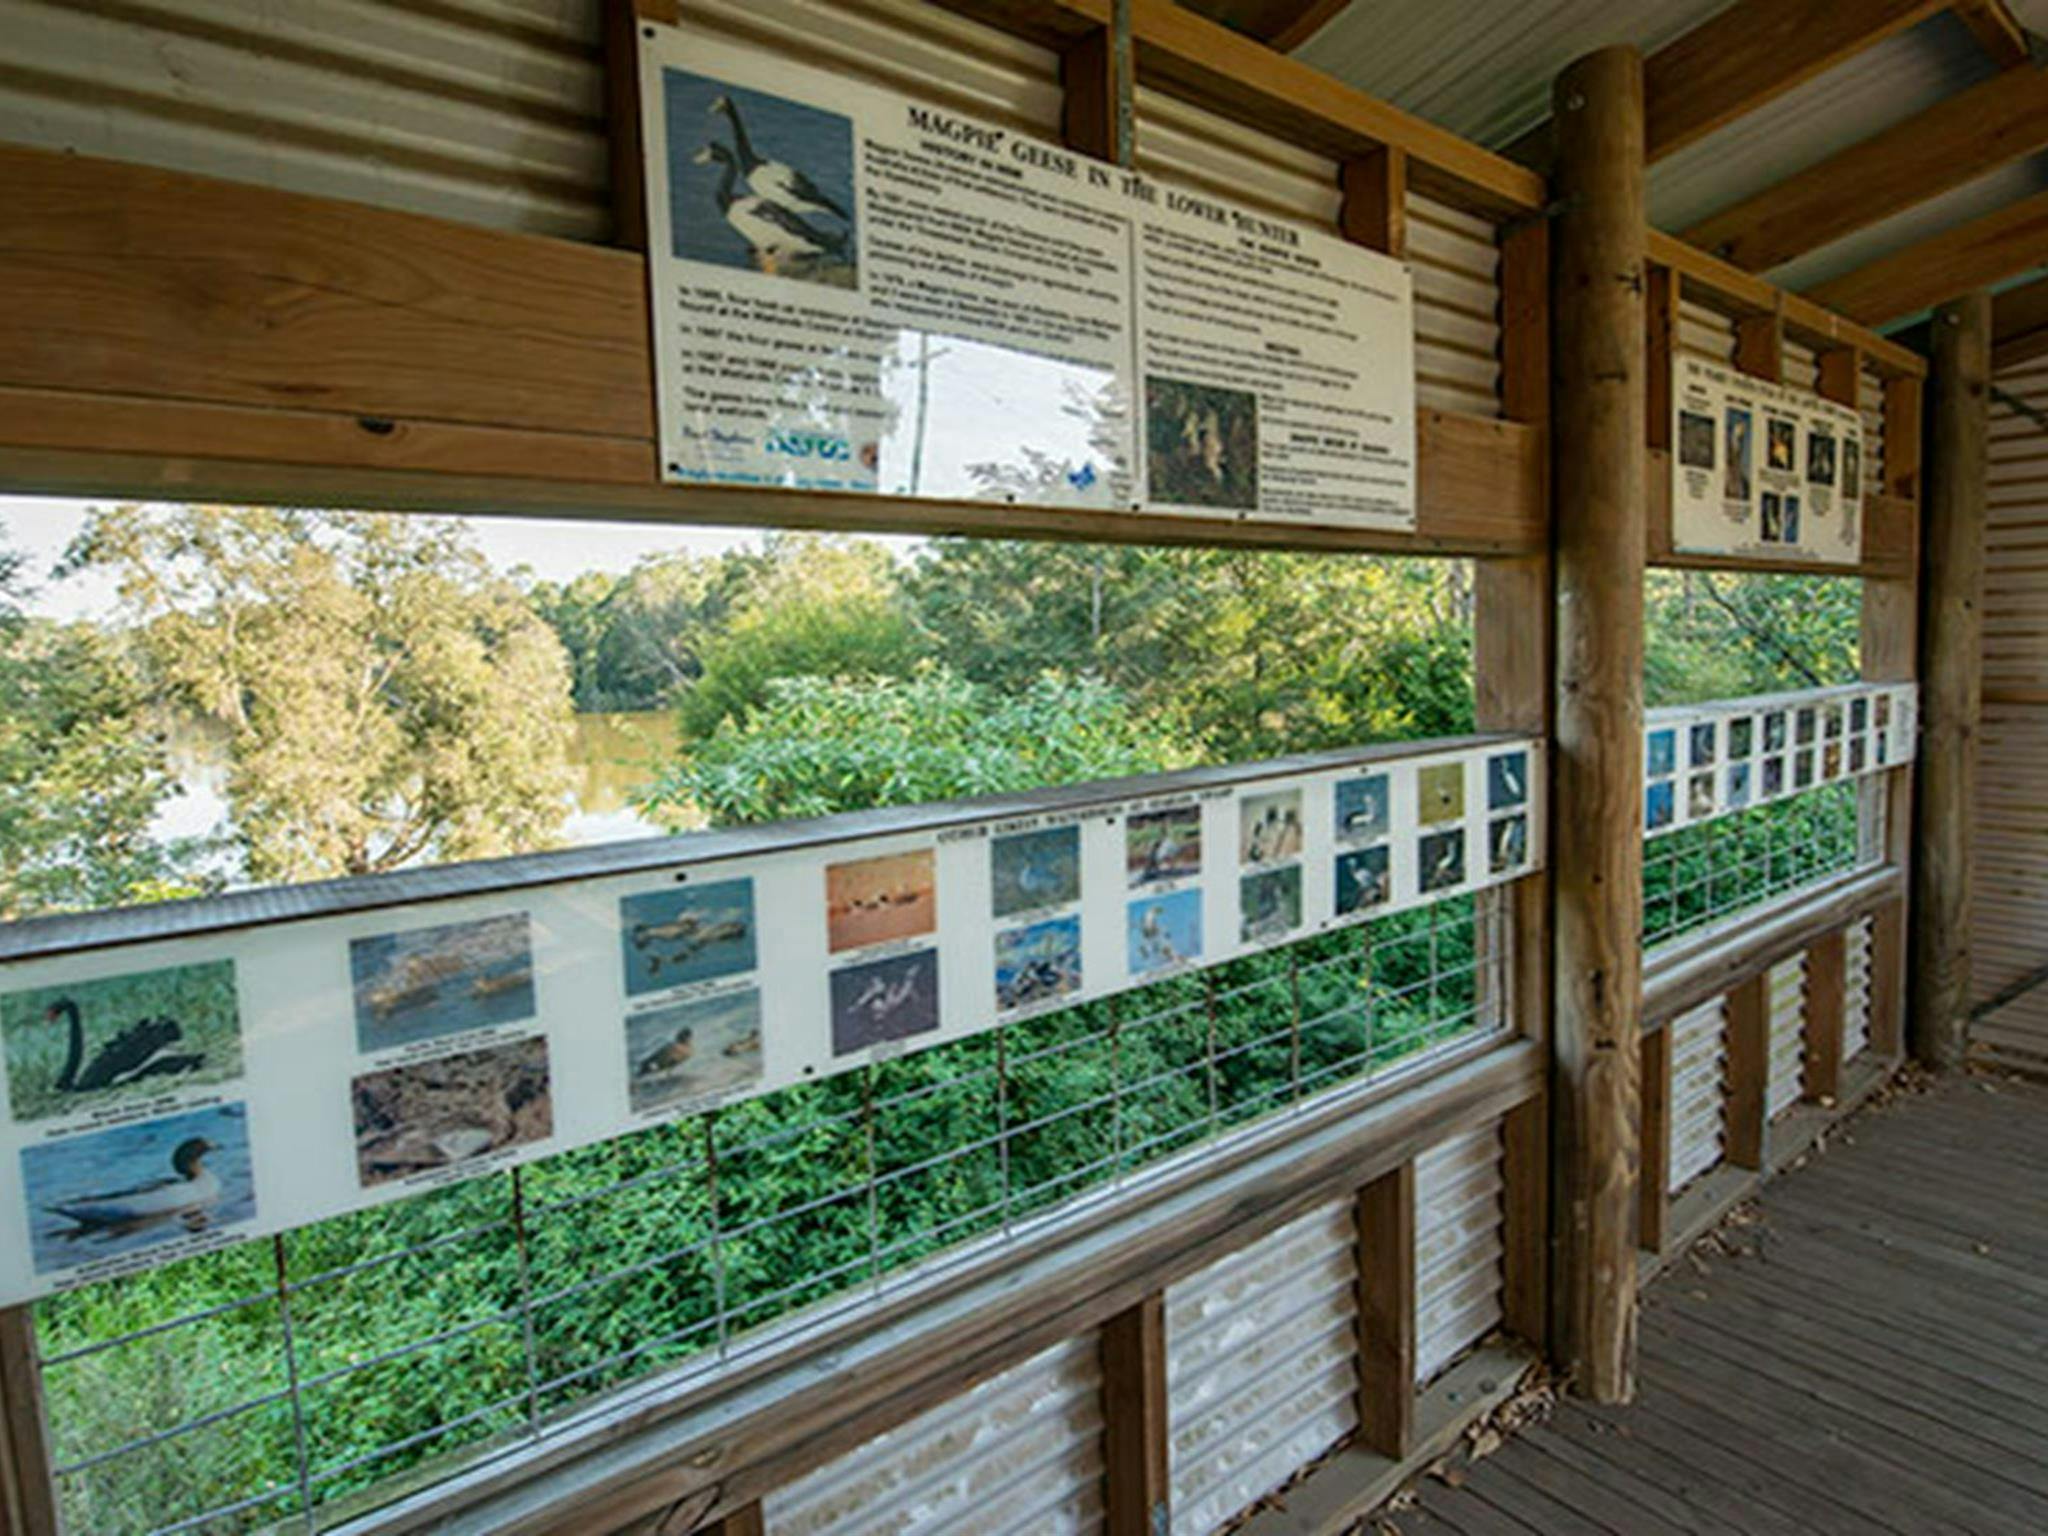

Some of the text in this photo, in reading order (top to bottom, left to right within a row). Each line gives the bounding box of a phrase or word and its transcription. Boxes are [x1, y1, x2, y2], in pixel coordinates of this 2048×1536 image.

[907, 107, 1000, 153] MAGPIE
[1012, 142, 1077, 178] GEESE
[1089, 168, 1110, 187] IN
[1121, 178, 1155, 203] THE
[1167, 192, 1228, 226] LOWER
[1238, 216, 1299, 246] HUNTER
